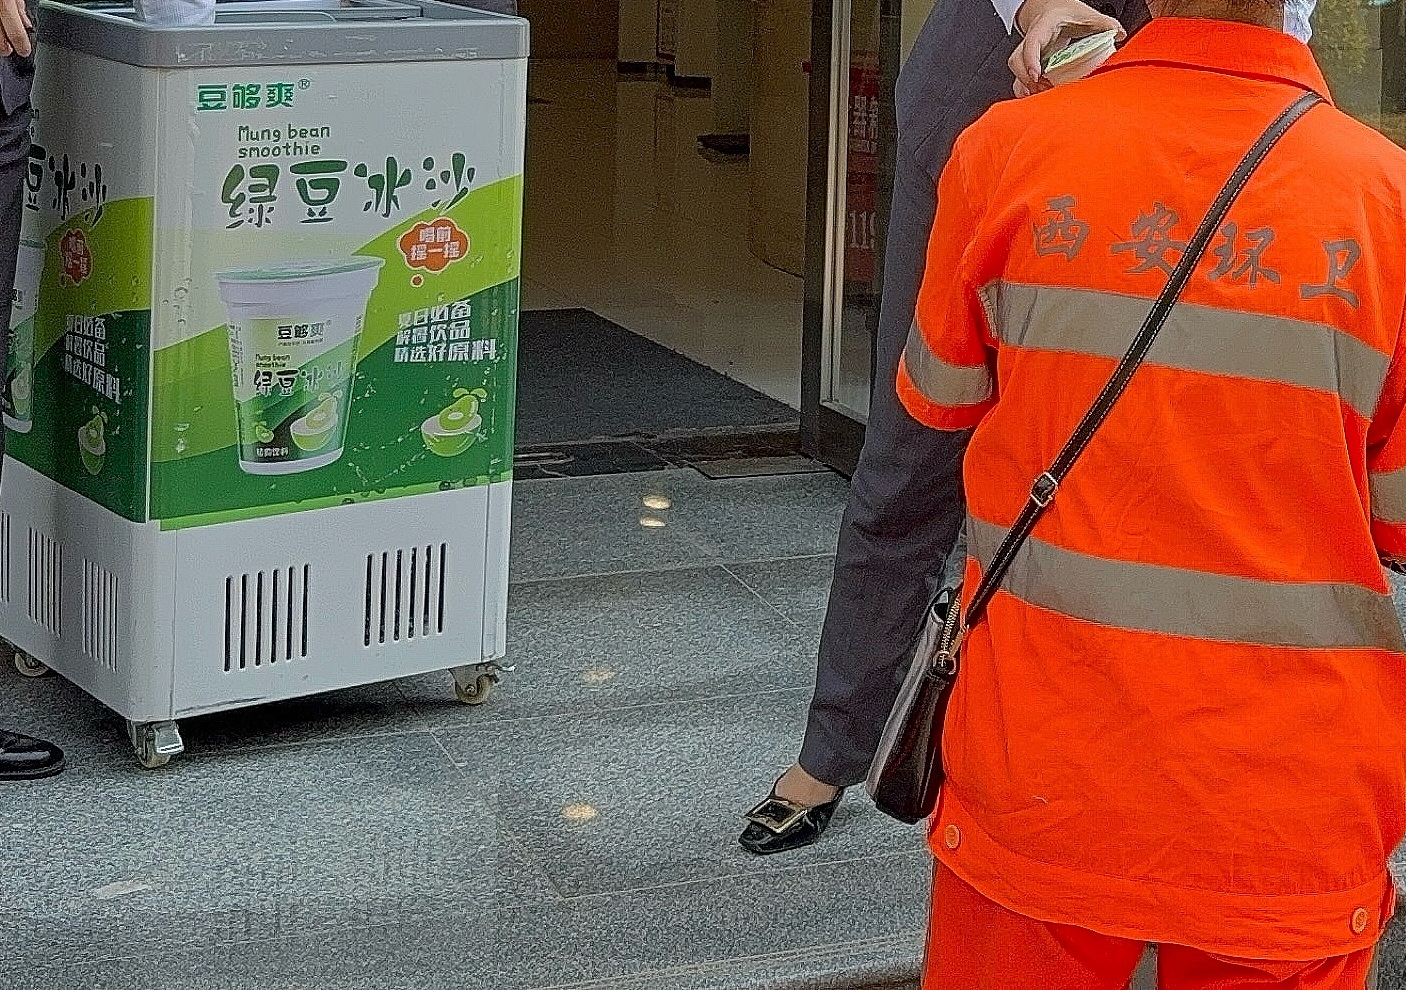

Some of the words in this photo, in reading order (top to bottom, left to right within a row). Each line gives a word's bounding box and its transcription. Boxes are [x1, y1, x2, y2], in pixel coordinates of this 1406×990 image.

[196, 82, 294, 111] 豆够爽
[239, 125, 281, 142] Mung
[288, 123, 331, 139] bean
[239, 141, 321, 159] smoothie
[221, 152, 476, 229] 绿豆冰沙
[1032, 194, 1362, 310] 西安环卫
